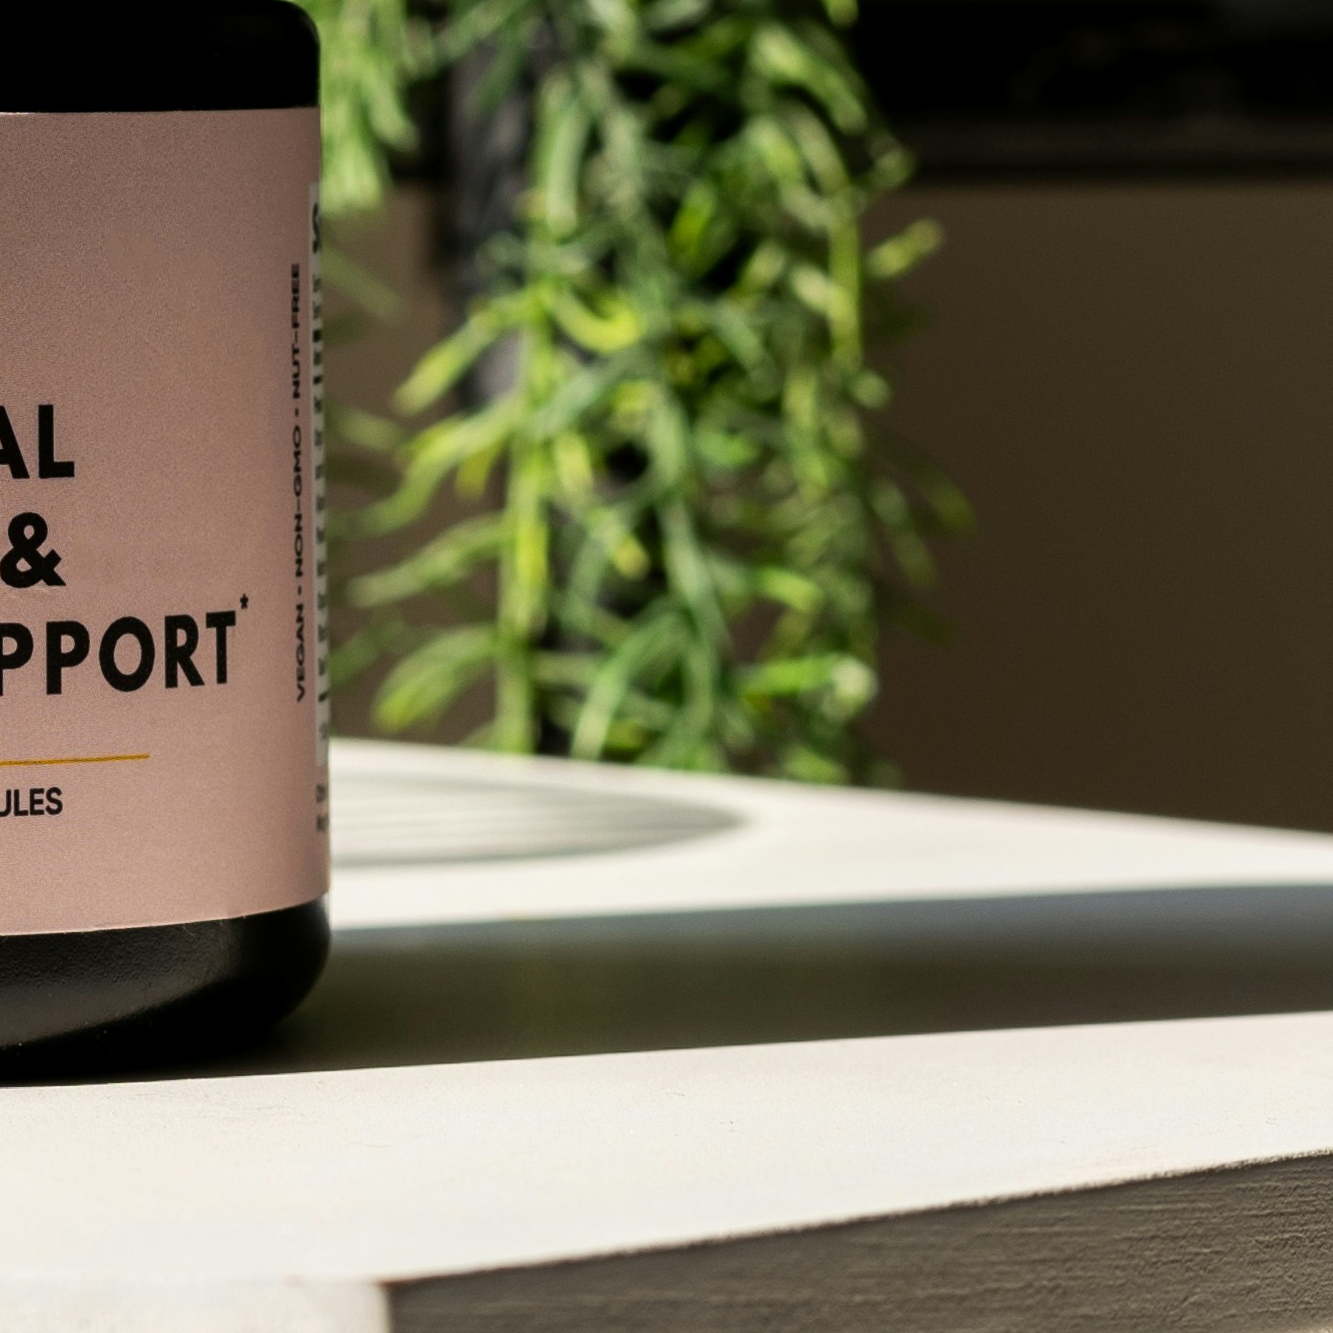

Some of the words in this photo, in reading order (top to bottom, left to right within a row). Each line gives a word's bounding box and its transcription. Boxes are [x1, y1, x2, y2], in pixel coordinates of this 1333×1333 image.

[290, 263, 301, 400] NUT-FREE
[291, 424, 304, 580] NON-GMO
[294, 605, 306, 704] VEGAN
